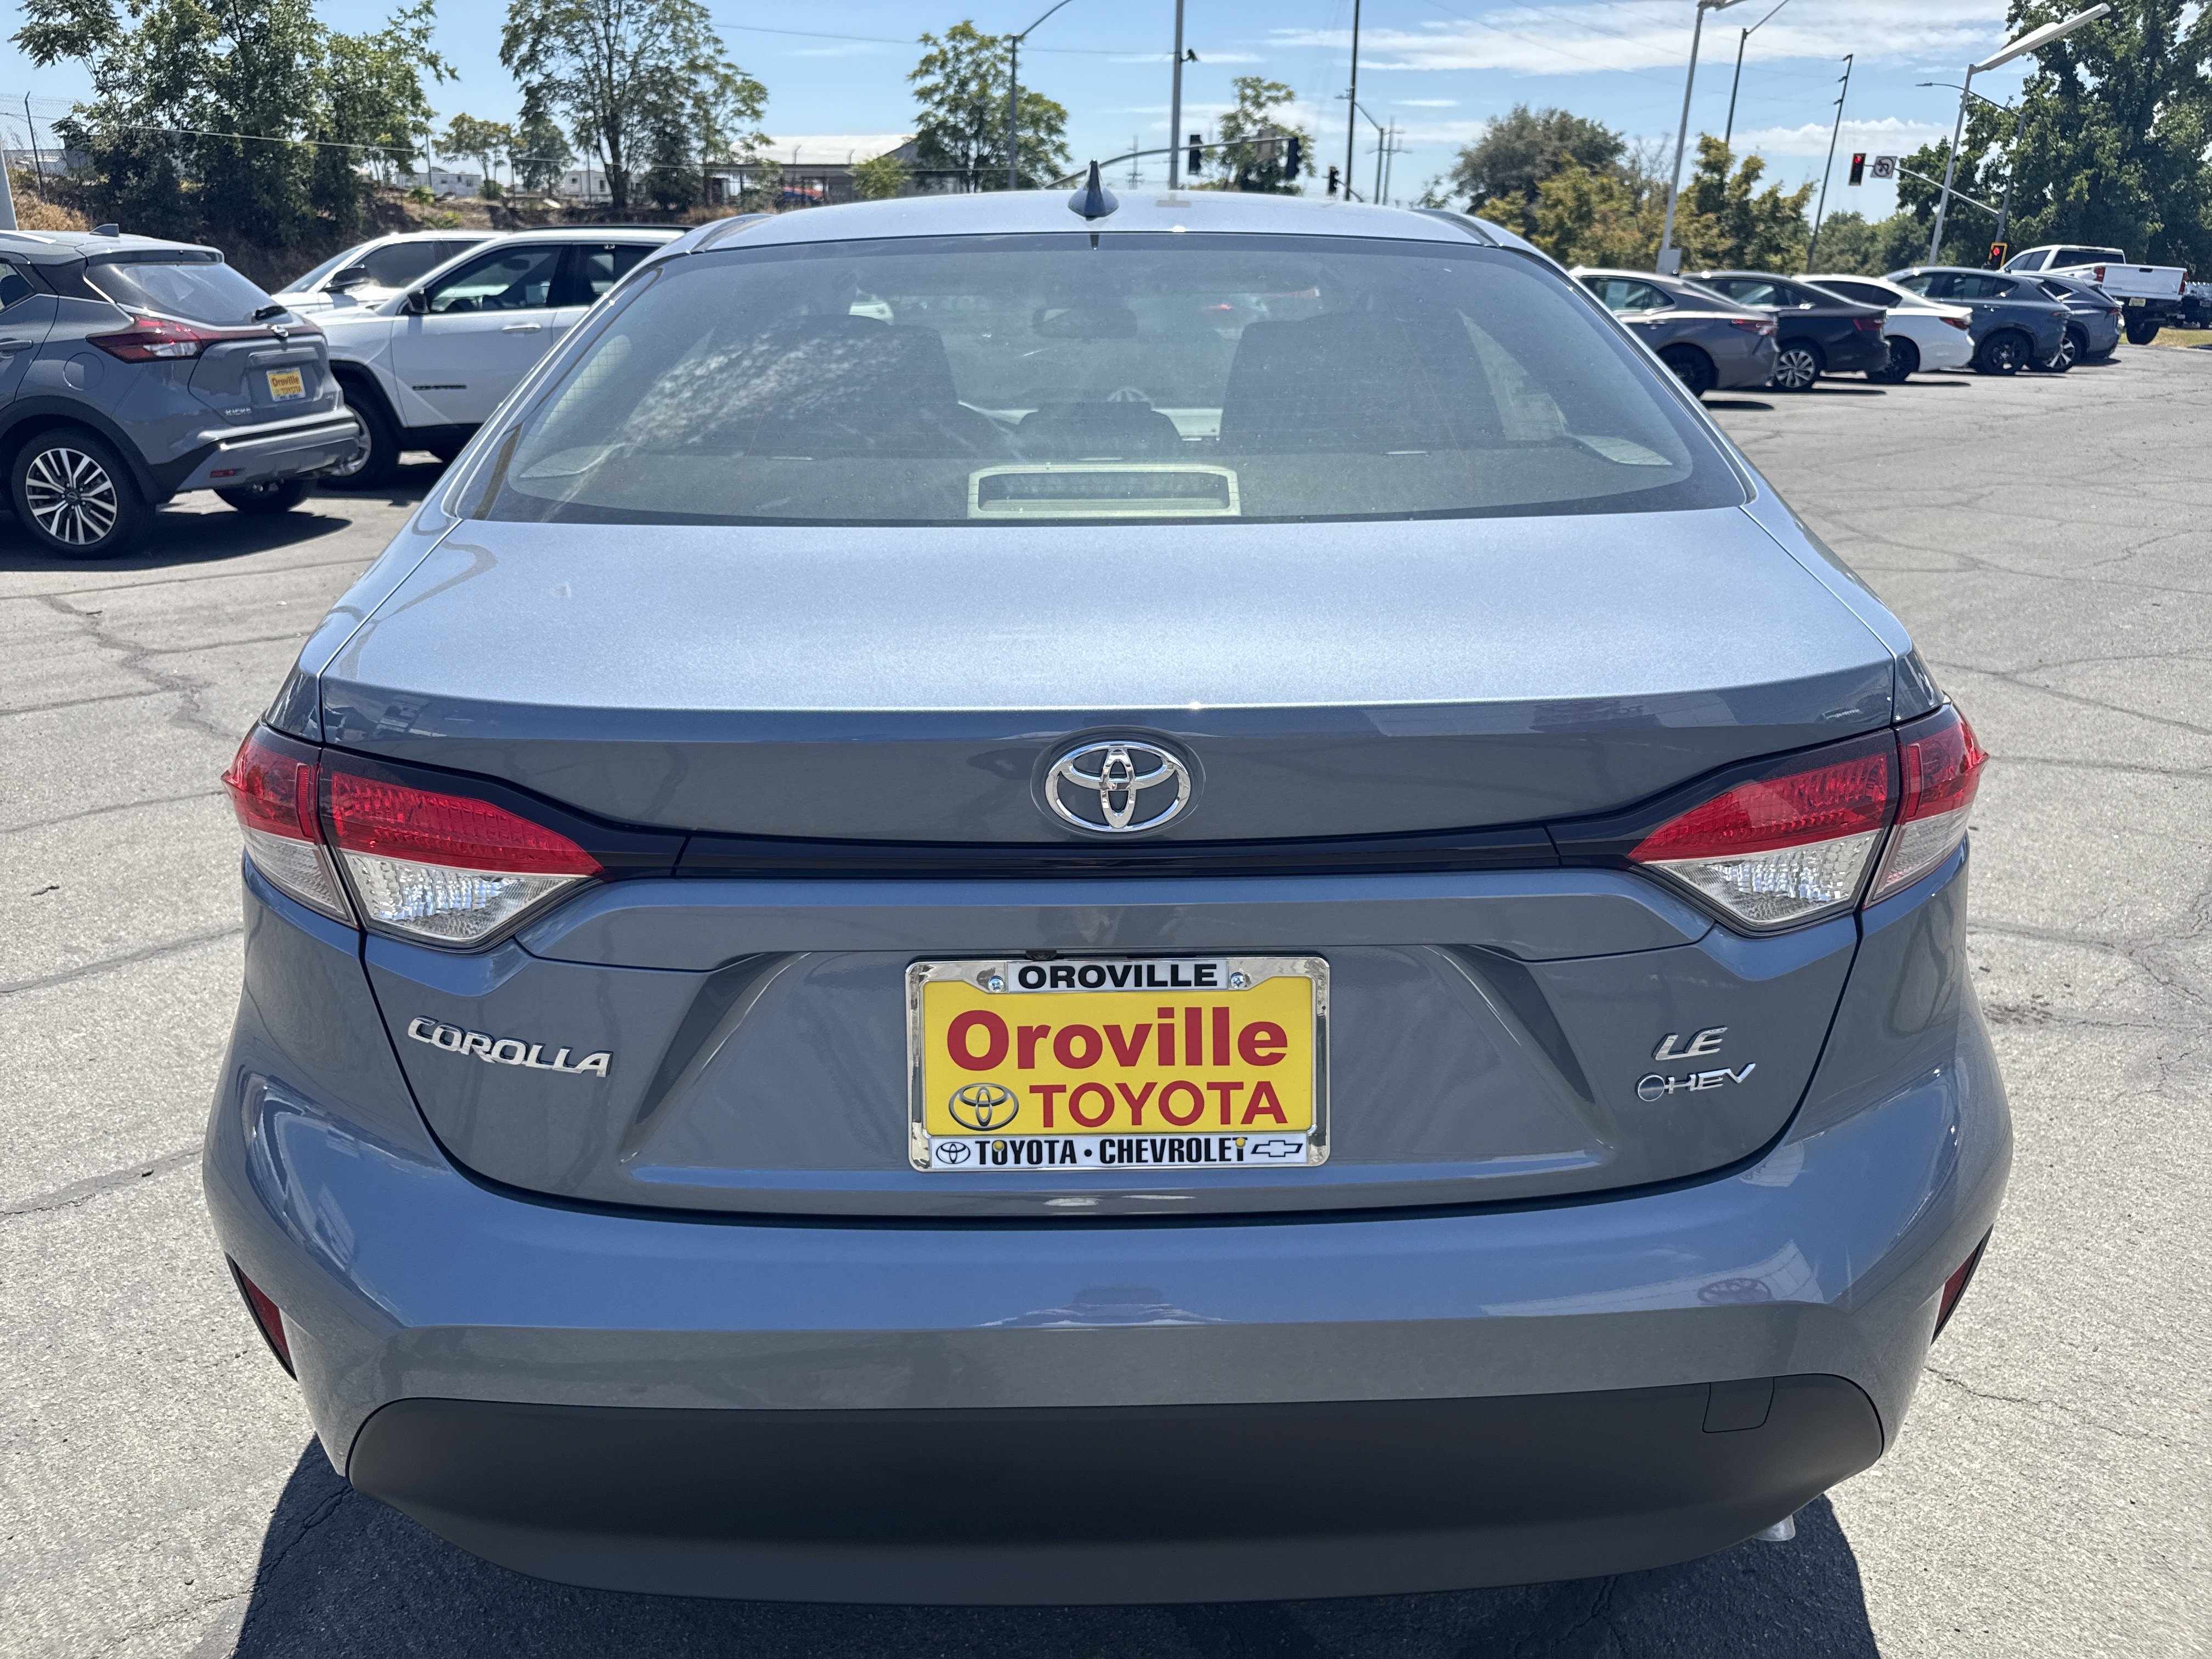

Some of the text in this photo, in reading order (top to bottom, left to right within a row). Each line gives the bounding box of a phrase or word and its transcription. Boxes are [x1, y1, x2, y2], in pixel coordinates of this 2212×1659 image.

[272, 375, 300, 387] Oroville
[1018, 963, 1217, 989] OROVILLE
[408, 1016, 613, 1077] COROLLA
[947, 1006, 1288, 1071] Oroville
[1652, 1026, 1728, 1060] LE
[1029, 1080, 1288, 1128] TOYOTA
[975, 1137, 1248, 1165] TOYOTA CHEVROLET
